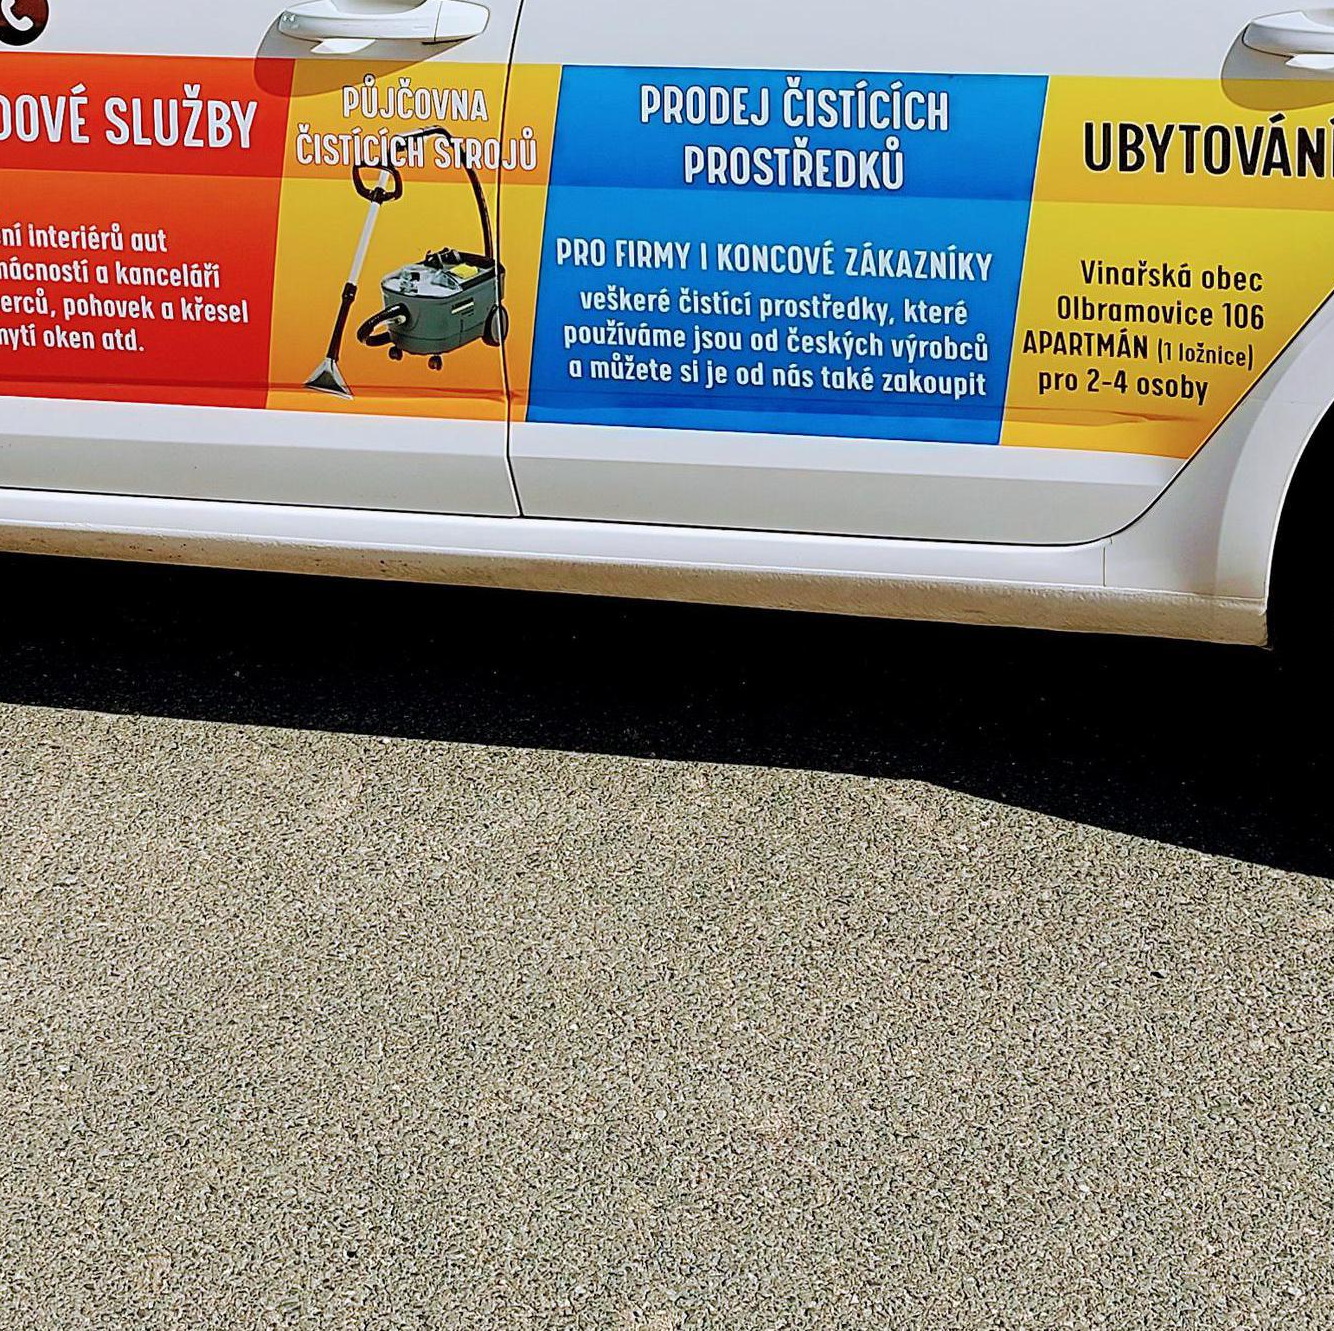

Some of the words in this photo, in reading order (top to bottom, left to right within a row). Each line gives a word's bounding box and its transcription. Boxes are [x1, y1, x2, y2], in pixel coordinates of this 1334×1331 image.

[104, 83, 258, 149] SLUŽBY
[342, 73, 489, 122] PŮJČOVNA
[641, 85, 769, 126] PRODEJ
[783, 76, 948, 131] ČISTÍCÍCH
[296, 123, 424, 167] ČISTÍCÍCH
[433, 126, 538, 172] STROJŮ
[684, 136, 903, 190] PROSTŘEDKŮ
[28, 222, 124, 251] interiérů
[131, 229, 167, 252] aut
[95, 265, 109, 284] a
[115, 261, 220, 288] kanceláří
[556, 238, 606, 267] PRO
[616, 240, 690, 269] FIRMY
[700, 242, 707, 270] I
[717, 240, 834, 275] KONCOVÉ
[845, 242, 992, 281] ZÁKAZNÍKY
[1080, 260, 1191, 288] Vinařská
[1201, 265, 1263, 292] obec
[63, 293, 155, 321] pohovek
[161, 302, 174, 320] a
[180, 296, 248, 323] křesel
[580, 285, 670, 313] veškeré
[679, 287, 751, 316] čistící
[760, 293, 894, 327] prostředky,
[904, 298, 967, 325] které
[1057, 295, 1213, 327] Olbramovice
[1222, 302, 1264, 330] 106
[43, 324, 95, 349] oken
[102, 328, 144, 352] atd.
[564, 319, 686, 349] používáme
[692, 325, 742, 354] jsou
[750, 328, 778, 352] od
[787, 326, 883, 360] českých
[891, 333, 988, 363] výrobců
[1023, 328, 1148, 359] APARTMÁN
[1157, 338, 1171, 364] (1
[1179, 342, 1253, 371] ložnice)
[569, 360, 582, 378] a
[590, 354, 672, 382] můžete
[680, 359, 699, 383] si
[705, 365, 727, 389] je
[736, 362, 764, 385] od
[772, 363, 814, 388] nás
[821, 366, 874, 391] také
[882, 369, 986, 400] zakoupit
[1039, 372, 1078, 395] pro
[1087, 368, 1128, 394] 2-4
[1137, 373, 1208, 406] osoby
